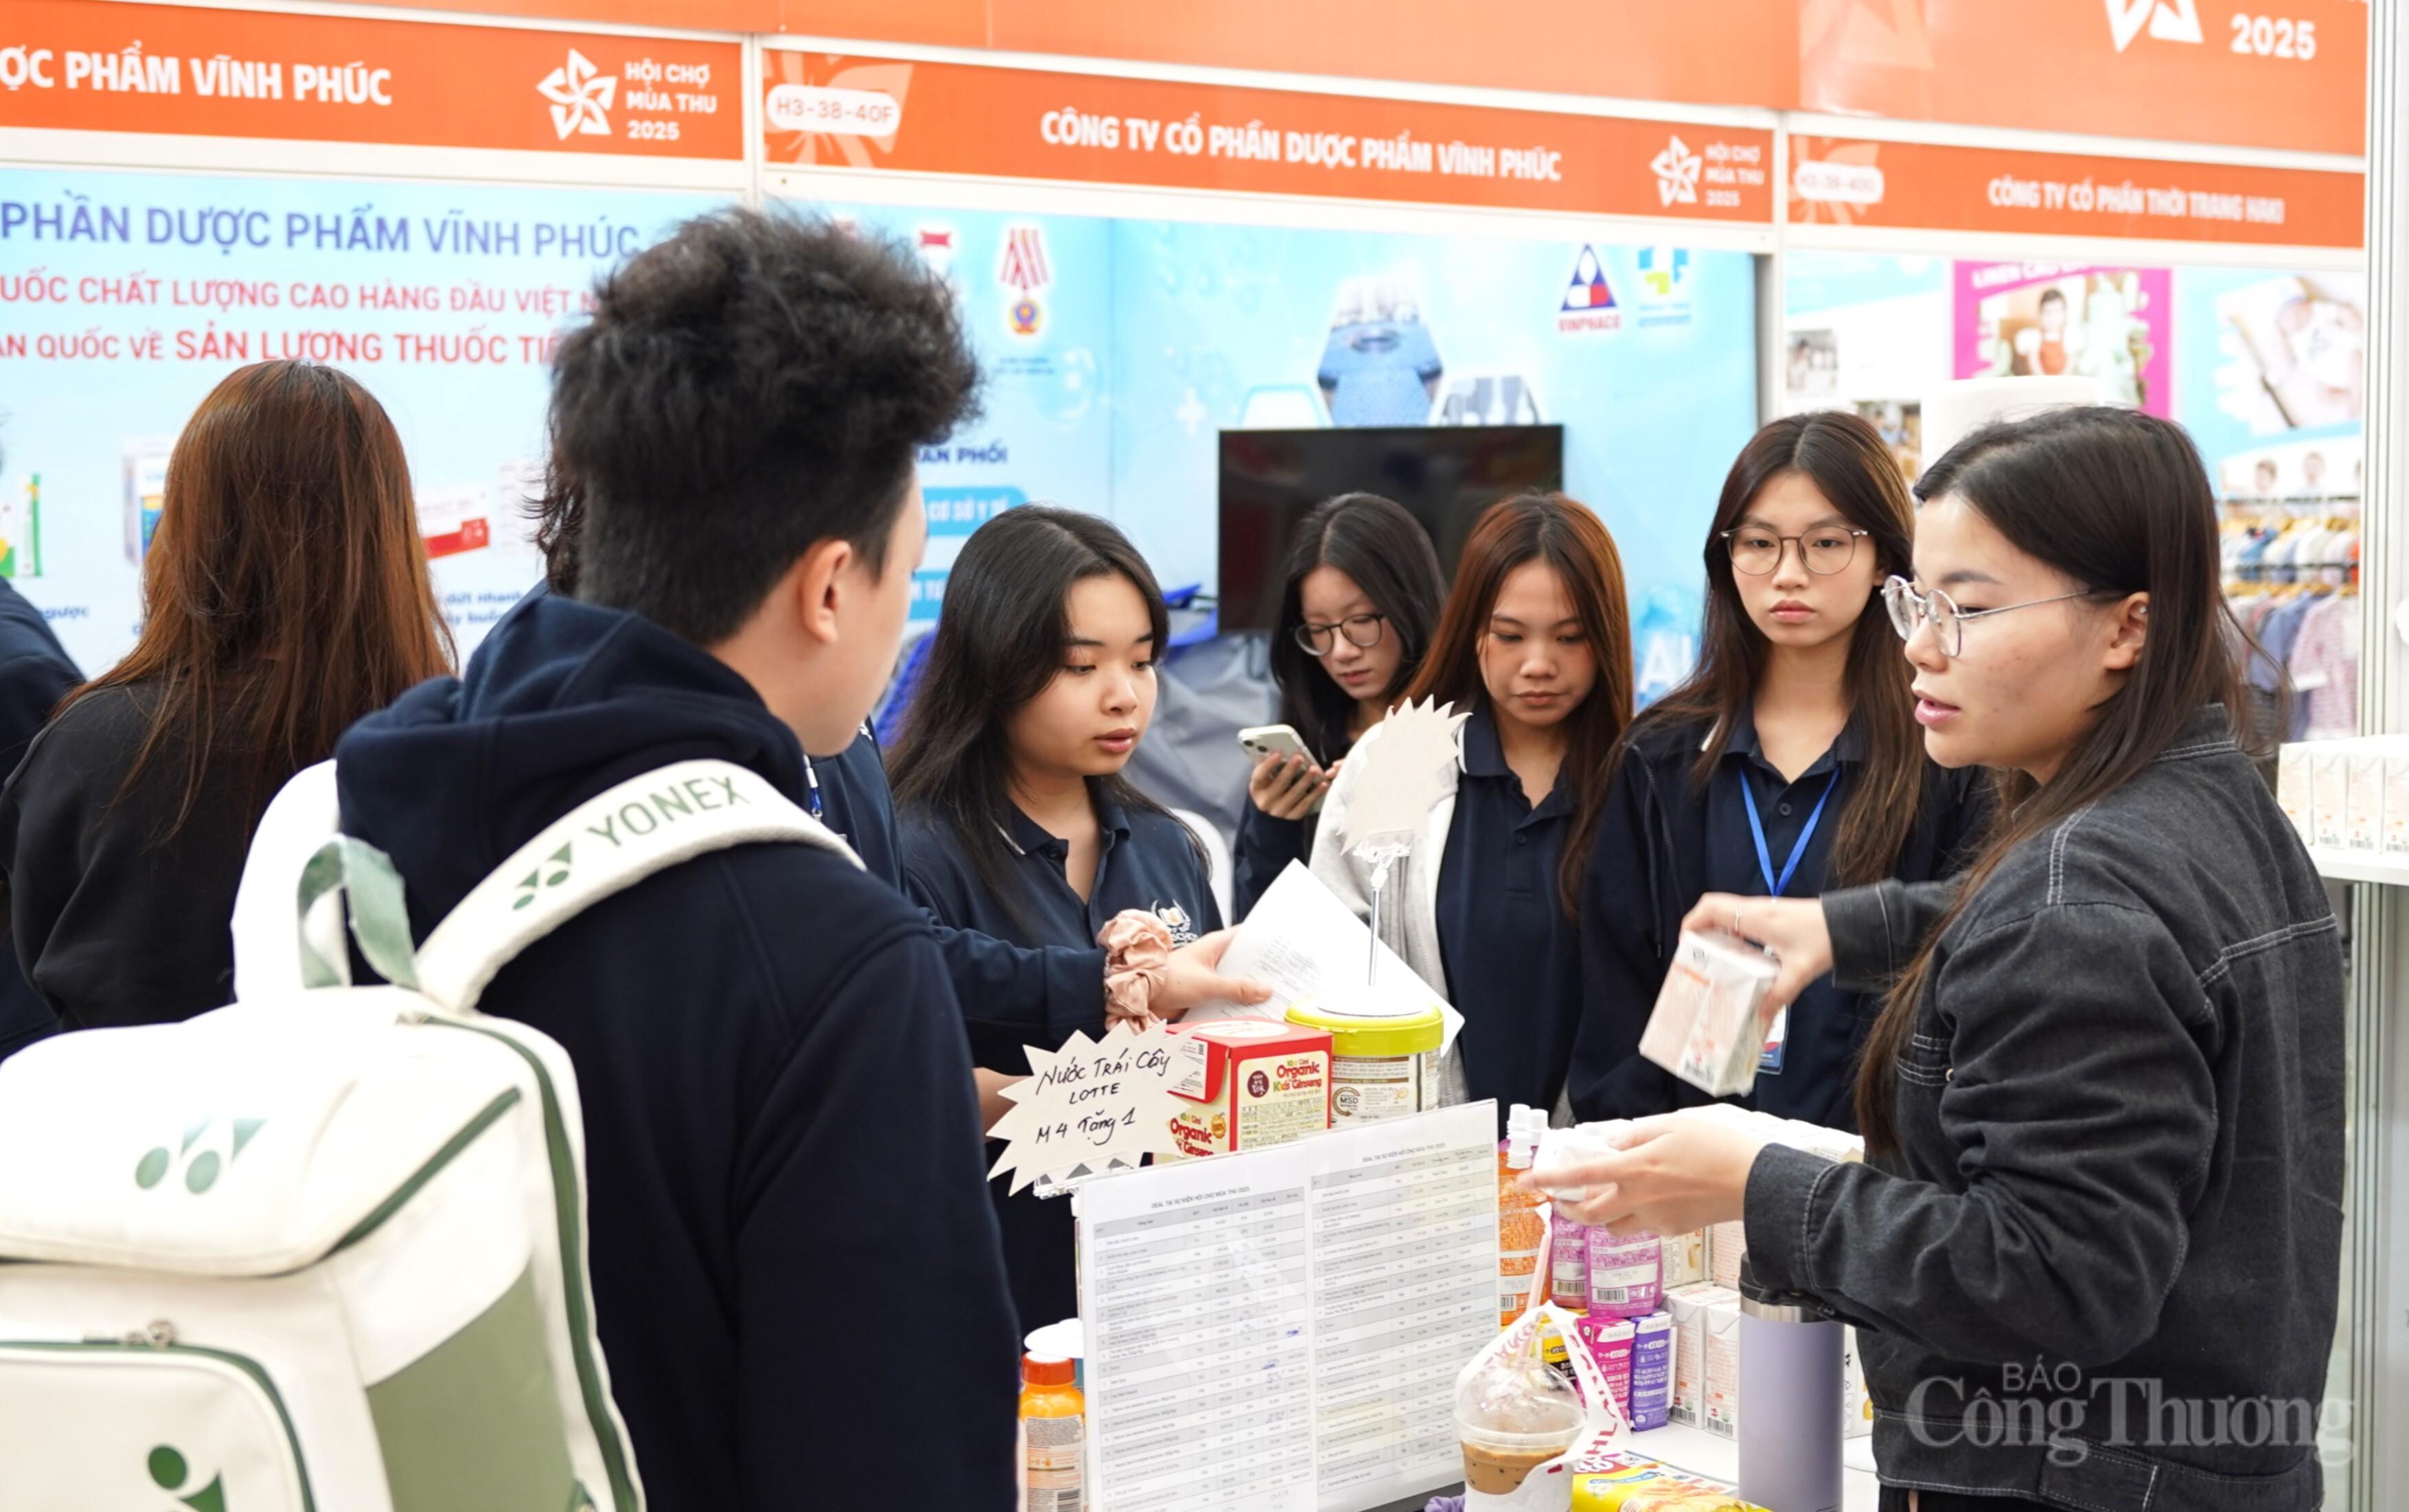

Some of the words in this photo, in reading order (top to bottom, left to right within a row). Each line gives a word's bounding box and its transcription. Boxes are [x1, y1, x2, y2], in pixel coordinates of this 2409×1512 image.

[2231, 14, 2316, 60] 2025
[65, 40, 181, 94] PHẨM
[189, 54, 283, 100] VĨNH
[293, 61, 392, 106] PHÚC
[625, 58, 661, 86] HỘI
[665, 63, 710, 89] CHỢ
[626, 87, 672, 111] MÙA
[676, 93, 717, 114] THU
[627, 120, 680, 141] 2025
[1041, 106, 1120, 148] CÔNG
[1125, 118, 1160, 152] TY
[1165, 111, 1203, 155] CỔ
[1286, 132, 1356, 168] DƯỢC
[1362, 130, 1432, 172] PHẨM
[1438, 141, 1495, 176] VĨNH
[1500, 146, 1562, 181] PHÚC
[1987, 174, 2040, 208] CÔNG
[2042, 181, 2067, 209] TY
[1, 189, 130, 242] PHẦN
[147, 207, 270, 255] DƯỢC
[286, 204, 409, 252] PHẨM
[424, 209, 520, 255] VĨNH
[534, 216, 638, 258] PHÚC
[79, 270, 163, 305] CHẤT
[172, 278, 279, 312] LƯỢNG
[290, 282, 349, 308] CAO
[360, 278, 441, 311] HÀNG
[450, 277, 506, 312] ĐẦU
[514, 281, 570, 318] VIỆT
[37, 326, 119, 359] QUỐC
[128, 327, 163, 359] VỀ
[176, 321, 248, 360] SẢN
[394, 325, 508, 363] THUỐC
[956, 437, 1007, 463] PHỐI
[586, 776, 750, 847] YONEX
[1277, 1061, 1319, 1078] Organic
[1069, 1082, 1120, 1105] LOTTE
[1122, 1107, 1136, 1126] 1
[1170, 1117, 1212, 1144] Organic
